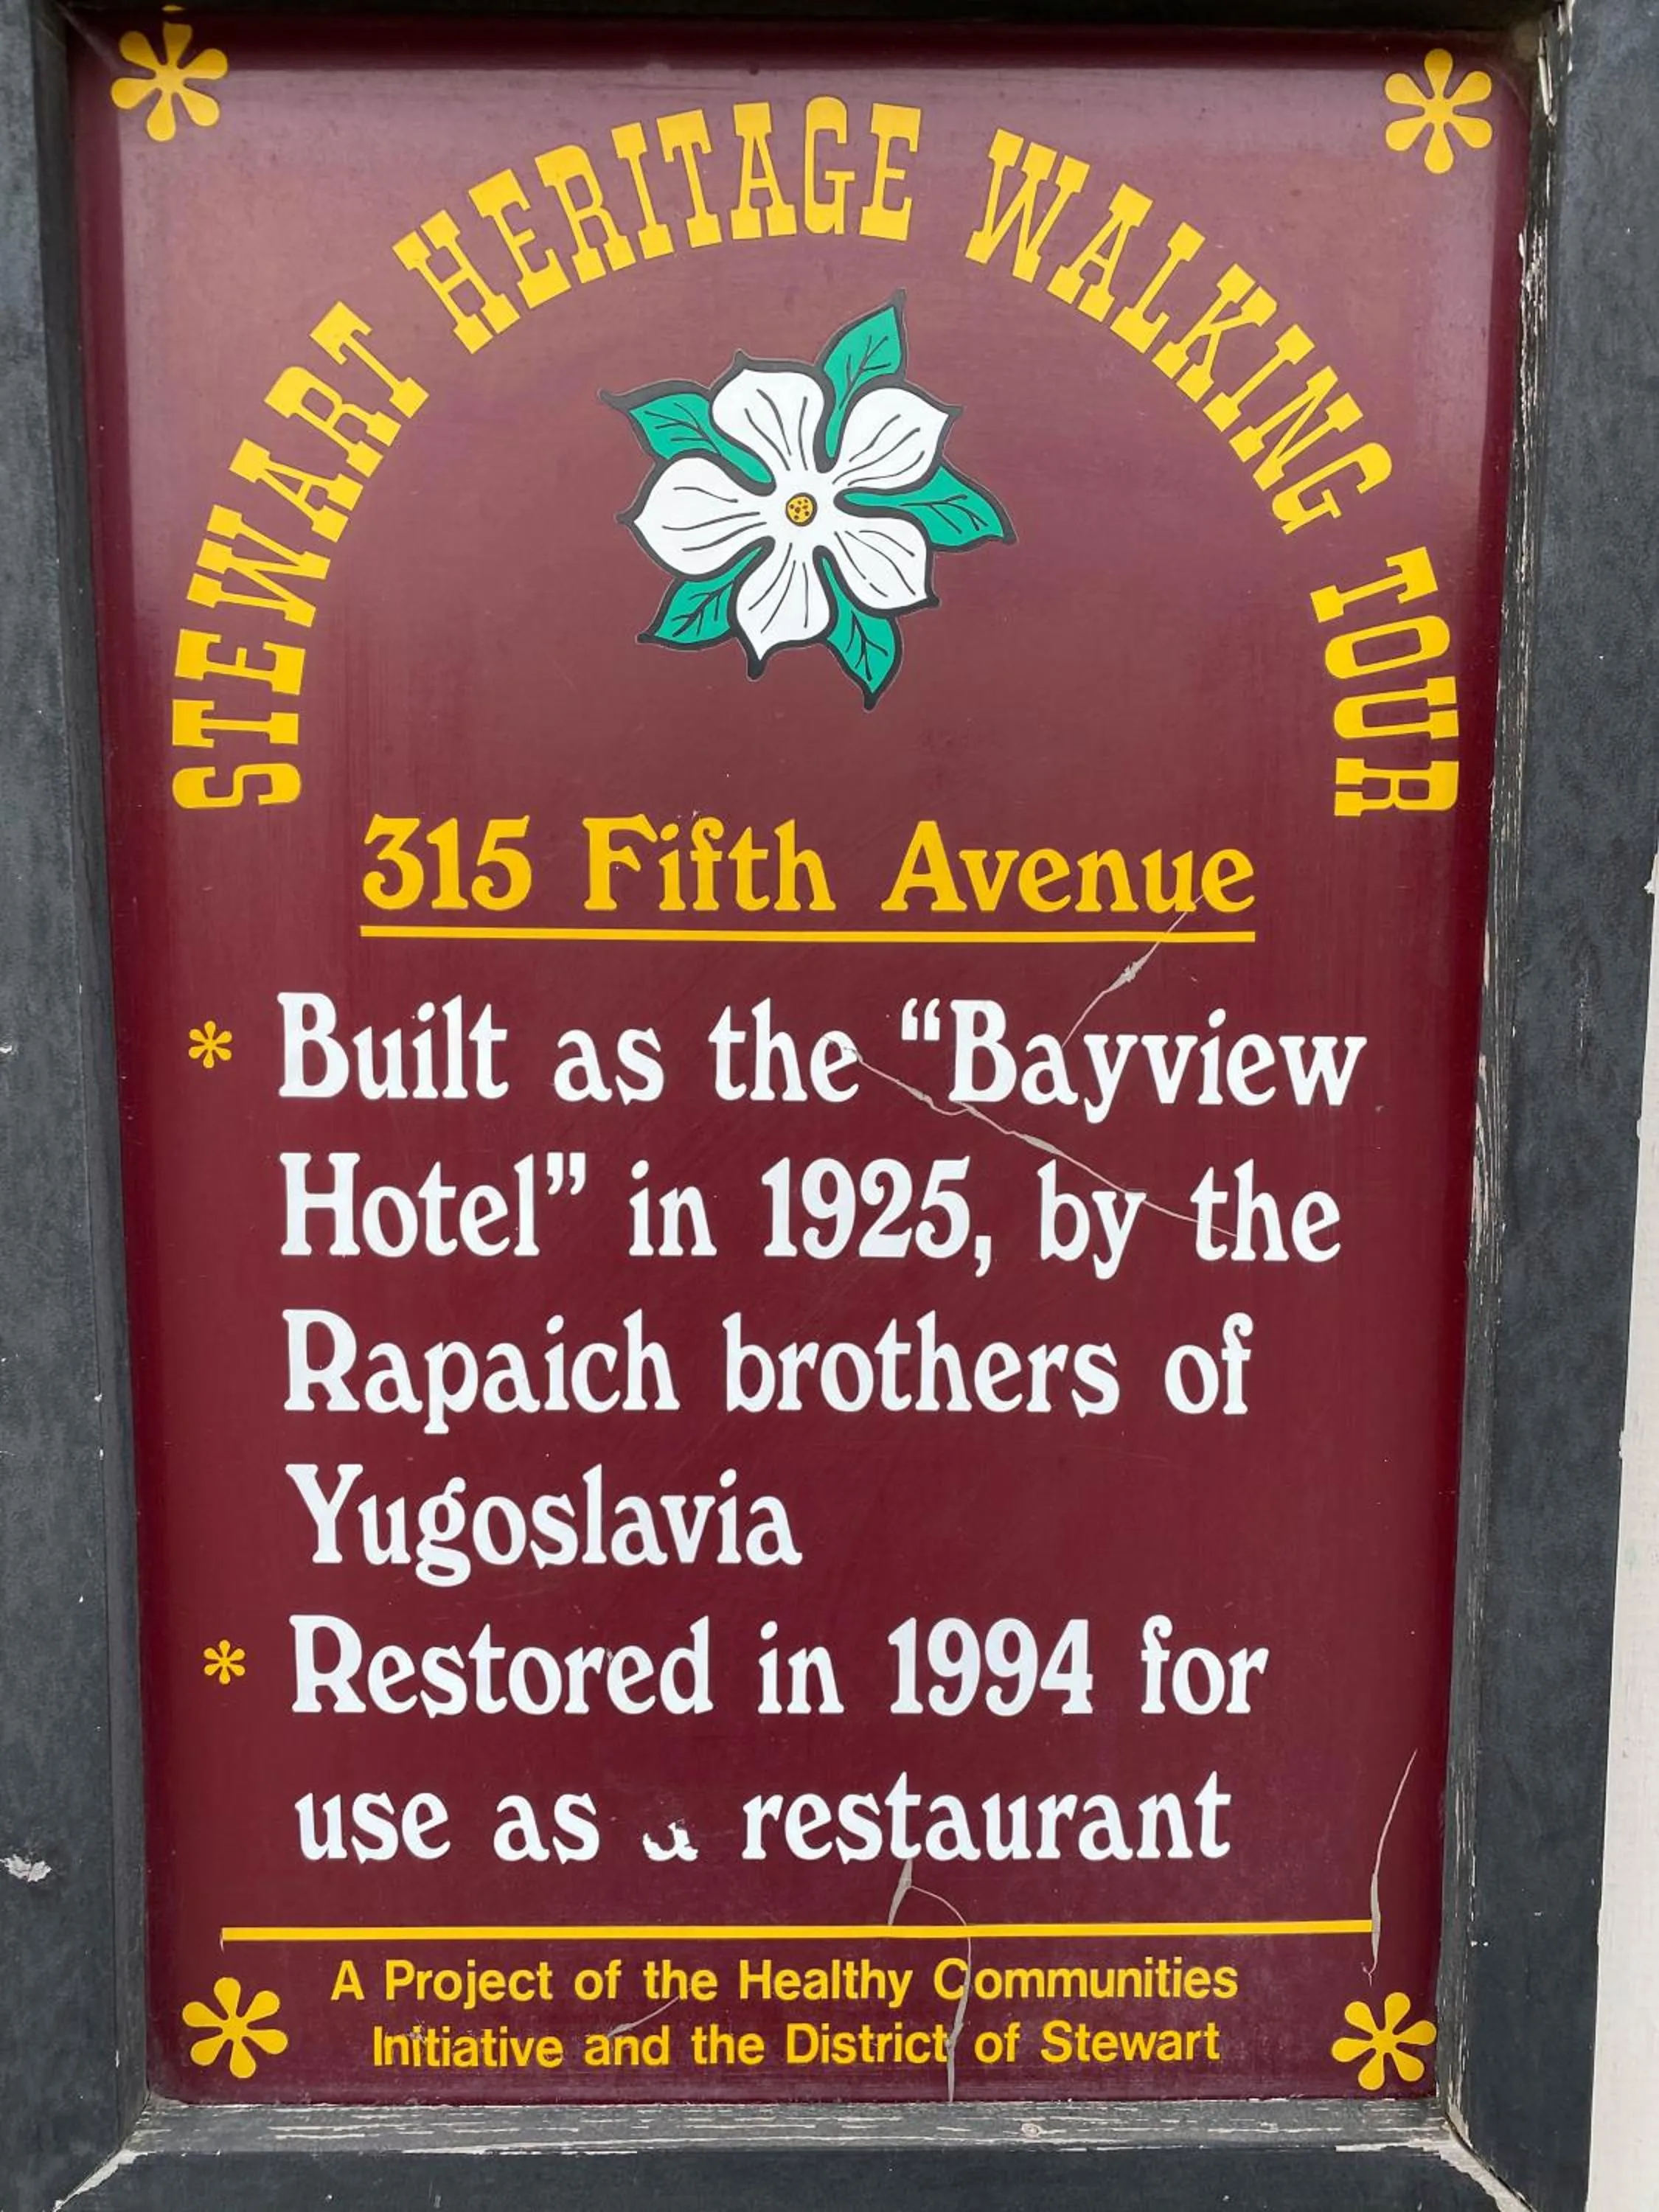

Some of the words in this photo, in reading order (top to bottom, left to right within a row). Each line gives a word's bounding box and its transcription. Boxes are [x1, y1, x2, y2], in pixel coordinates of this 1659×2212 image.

[173, 300, 429, 811] STEWART
[392, 97, 922, 355] HERITAGE
[964, 128, 1394, 536] WALKING
[1310, 546, 1460, 818] TOUR
[361, 814, 531, 912] 315
[582, 814, 837, 914] Fifth
[881, 818, 1256, 914] Avenue
[277, 992, 509, 1102] Built
[553, 1027, 664, 1106] as
[708, 998, 861, 1104] the
[901, 998, 1368, 1127] “Bayview
[279, 1152, 586, 1259] Hotel”
[628, 1159, 717, 1258] in
[761, 1156, 992, 1279] 1925,
[1037, 1159, 1147, 1281] by
[1190, 1159, 1342, 1264] the
[282, 1308, 681, 1436] Rapaich
[722, 1310, 1121, 1419] brothers
[1164, 1312, 1253, 1416] of
[285, 1464, 803, 1587] Yugoslavia
[289, 1614, 714, 1719] Restored
[757, 1621, 844, 1716] in
[888, 1617, 1093, 1717] 1994
[1141, 1614, 1270, 1716] for
[294, 1792, 451, 1865] use
[493, 1792, 600, 1865] as
[741, 1770, 1232, 1865] restaurant
[331, 1960, 365, 2001] A
[386, 1959, 553, 2010] Project
[574, 1959, 622, 2001] of
[642, 1959, 717, 2002] the
[740, 1958, 914, 2009] Healthy
[933, 1958, 1239, 2002] Communities
[374, 2025, 563, 2068] Initiative
[584, 2025, 669, 2067] and
[691, 2023, 765, 2066] the
[787, 2022, 950, 2065] District
[974, 2022, 1021, 2065] of
[1040, 2020, 1220, 2064] Stewart
